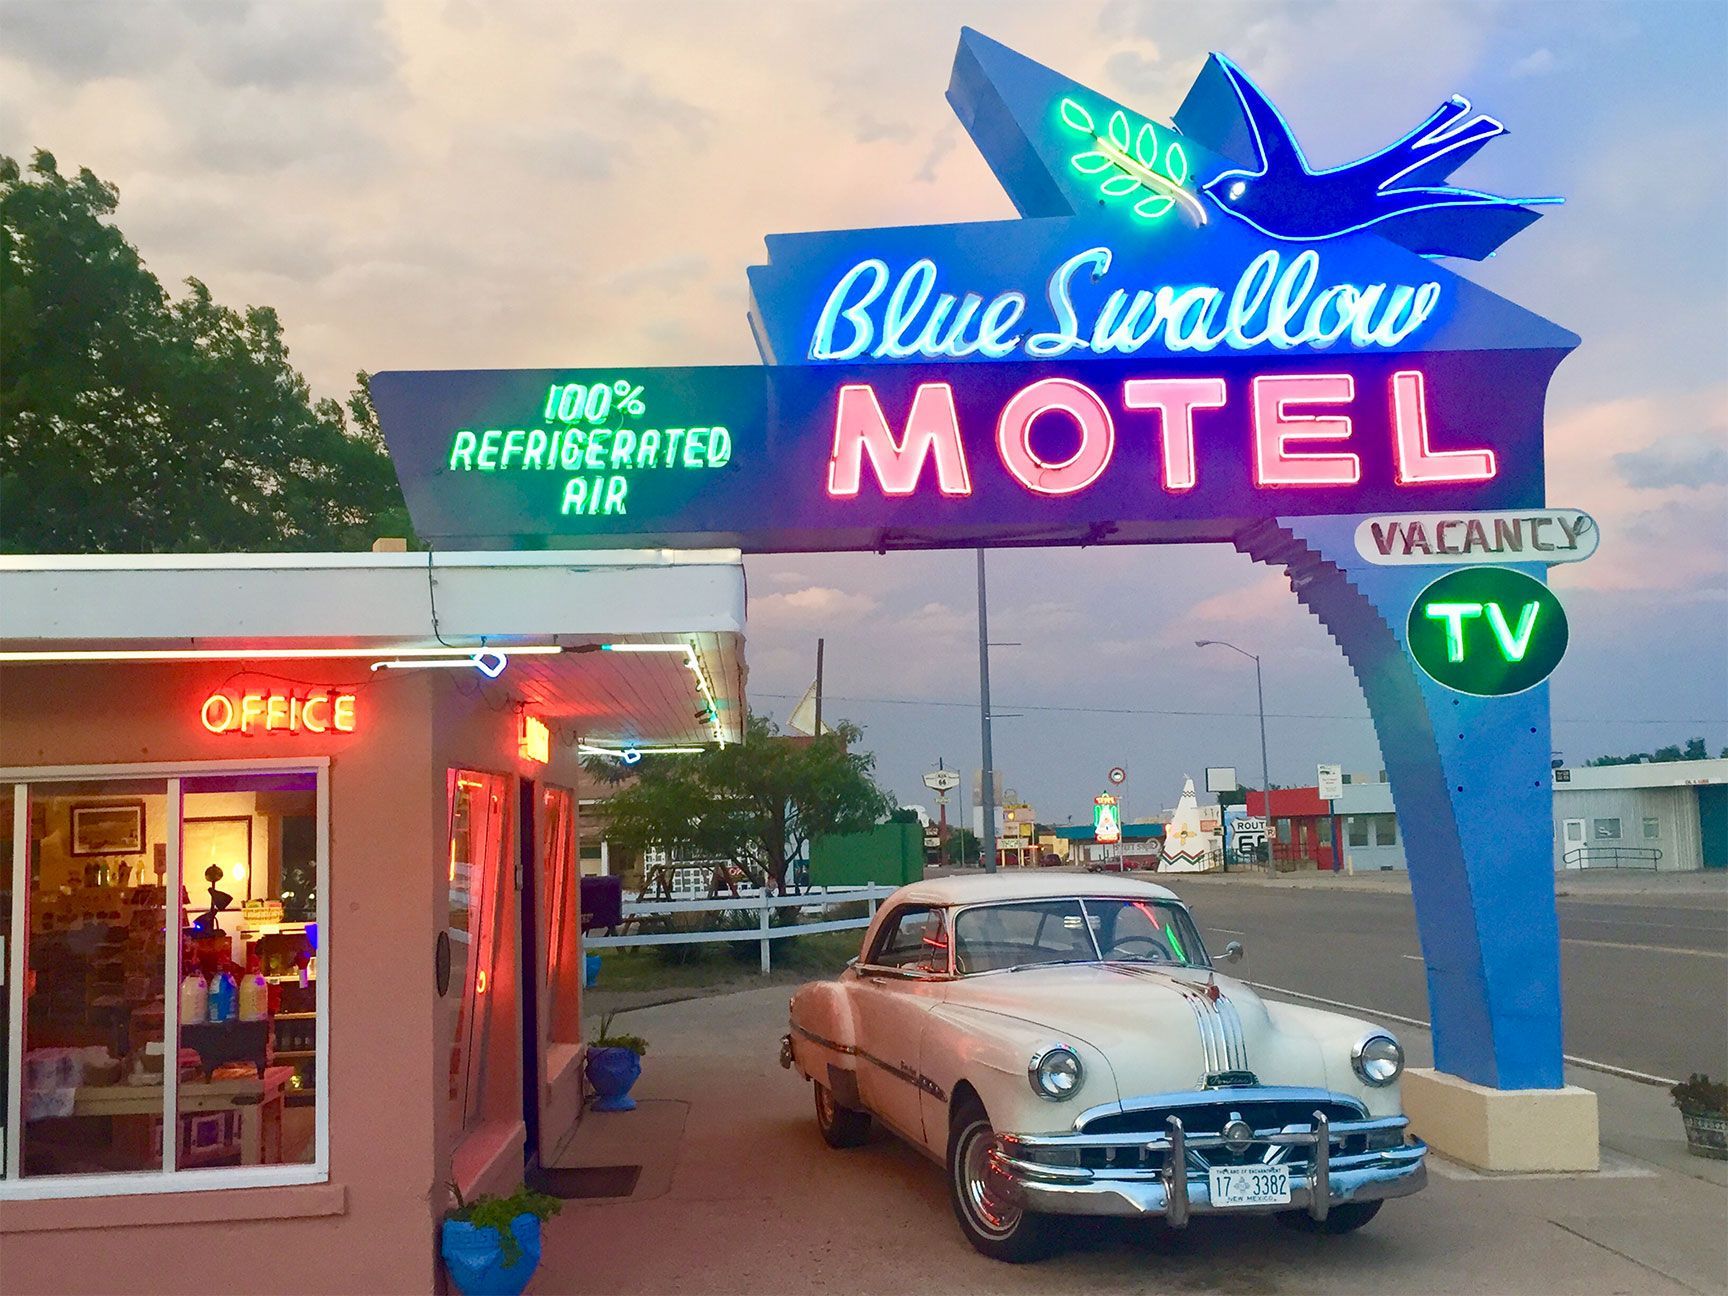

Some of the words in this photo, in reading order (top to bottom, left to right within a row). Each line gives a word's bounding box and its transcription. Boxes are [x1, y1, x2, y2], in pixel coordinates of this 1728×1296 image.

[808, 259, 1026, 360] Blue
[1026, 249, 1441, 358] Swallow
[544, 379, 646, 424] 100%
[449, 426, 732, 471] REFRIGERATED
[827, 371, 1498, 495] MOTEL
[561, 475, 629, 515] AIR
[1371, 515, 1586, 556] VACANCY
[1425, 600, 1540, 663] TV
[201, 694, 356, 734] OFFICE
[1216, 1176, 1232, 1197] 17
[1252, 1175, 1287, 1196] 3382
